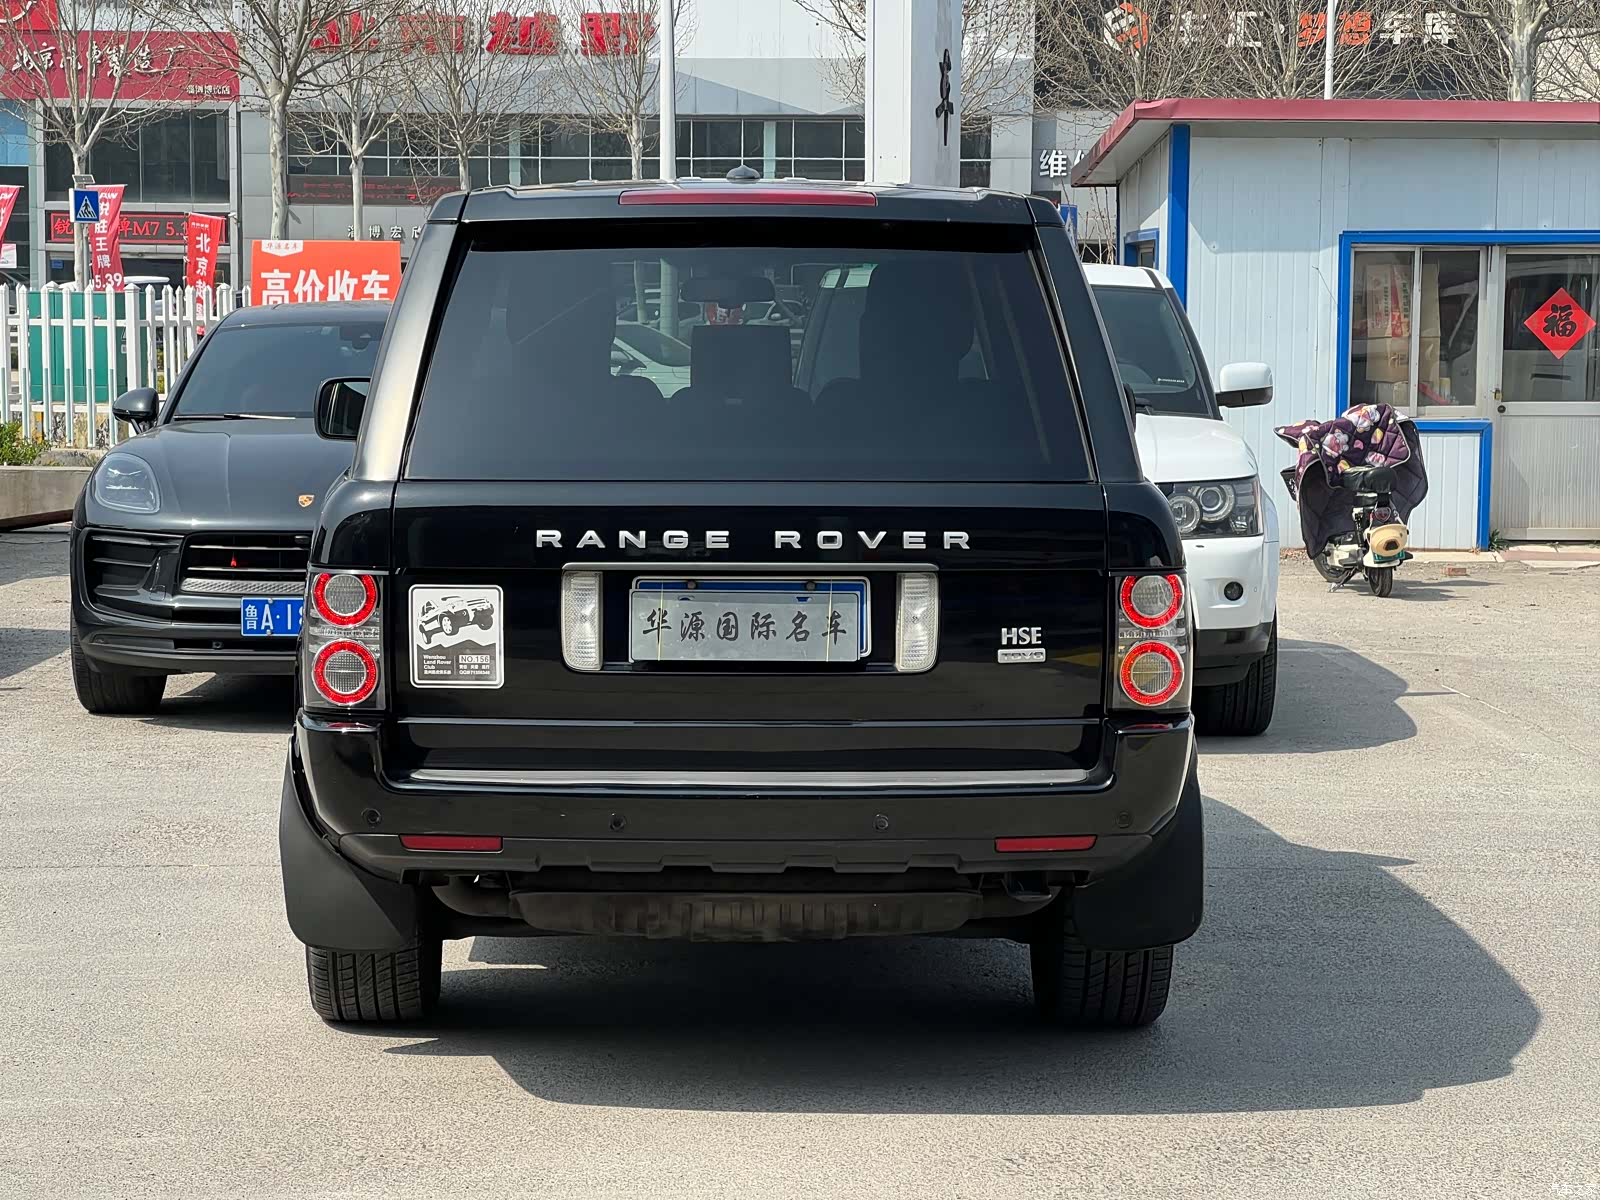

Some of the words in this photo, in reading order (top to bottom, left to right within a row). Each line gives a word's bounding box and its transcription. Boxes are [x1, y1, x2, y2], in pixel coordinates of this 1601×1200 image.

[260, 268, 391, 305] 高价收车
[1543, 303, 1577, 337] 福
[536, 530, 730, 549] RANGE
[774, 530, 970, 550] ROVER
[642, 607, 847, 645] 华源国际名车
[1001, 626, 1042, 645] HSE
